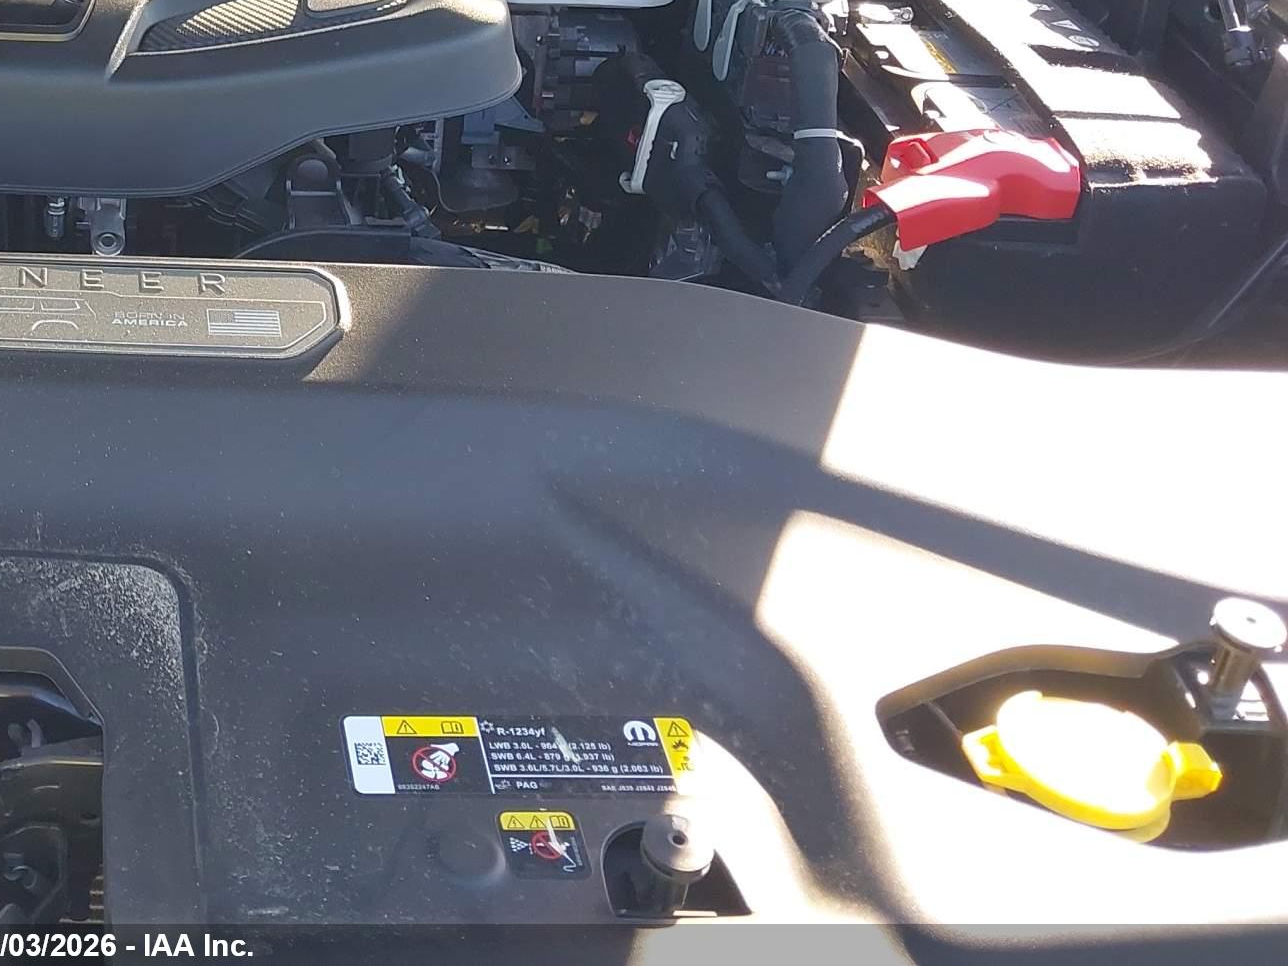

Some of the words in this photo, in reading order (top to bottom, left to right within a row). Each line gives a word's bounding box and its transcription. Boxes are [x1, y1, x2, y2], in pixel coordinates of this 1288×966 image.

[112, 319, 188, 327] AMERICA
[496, 727, 545, 737] R-1234yf
[489, 742, 511, 750] LWB
[598, 742, 612, 752] lb)
[602, 754, 615, 762] lb)
[494, 764, 518, 772] SWB
[650, 765, 663, 774] lb)
[516, 781, 538, 789] PAG
